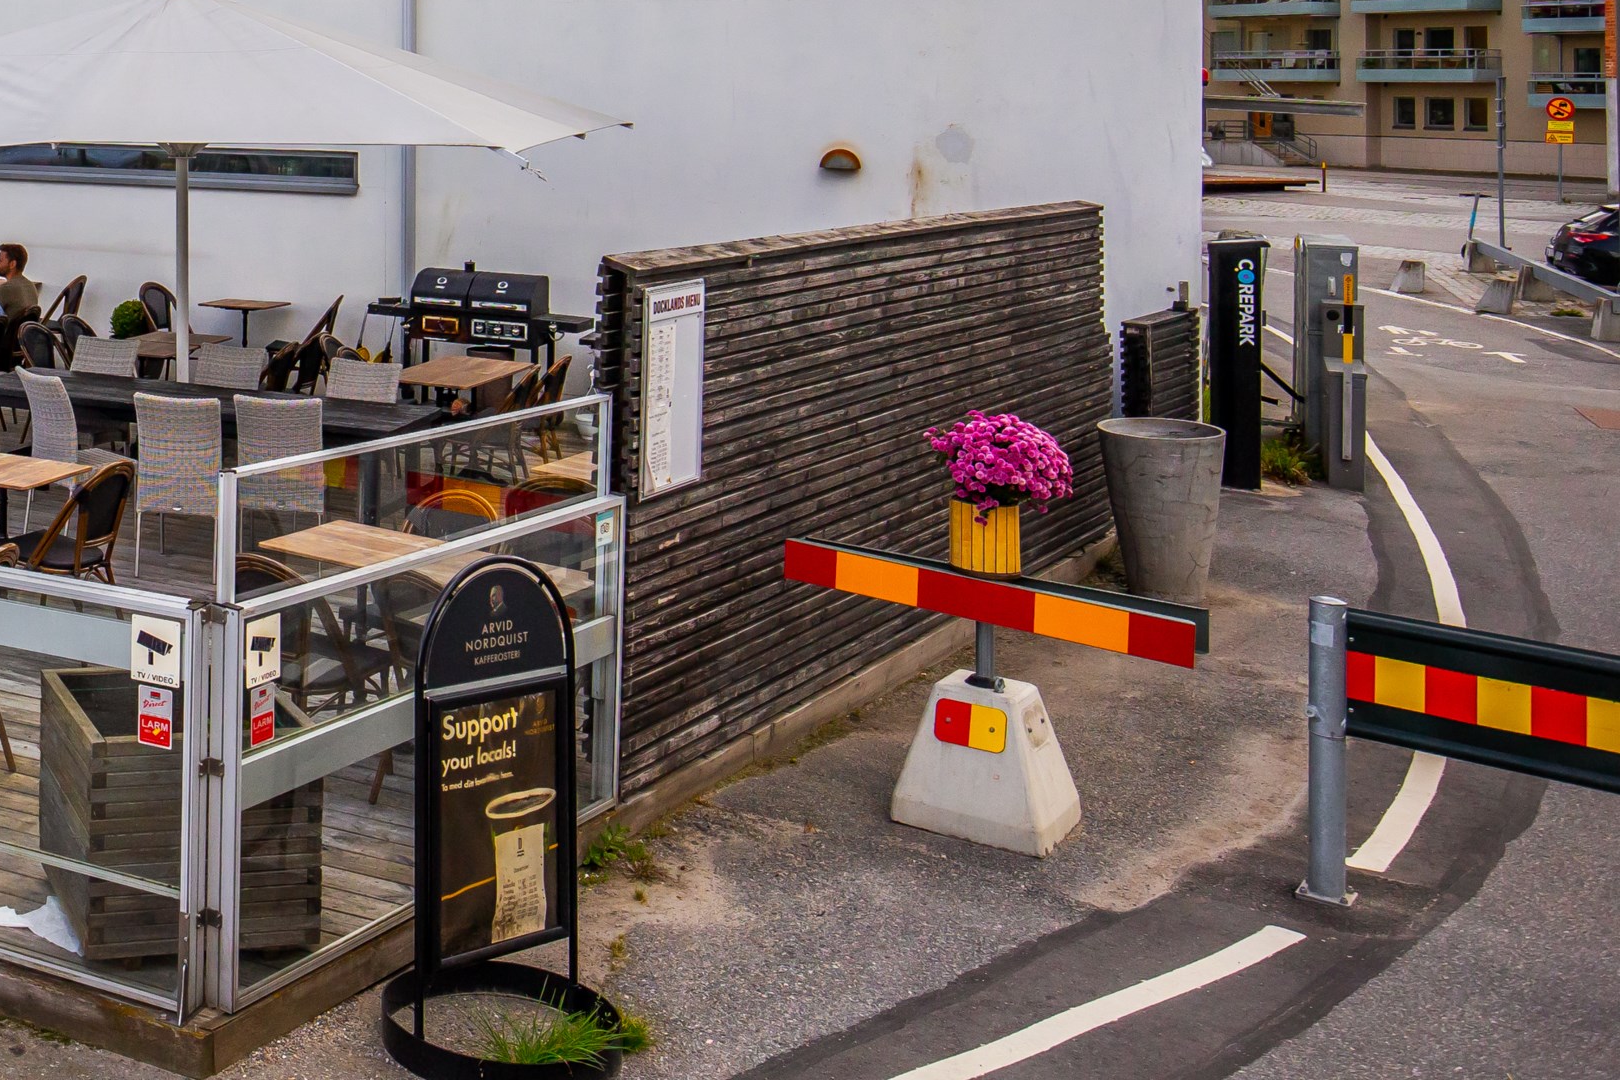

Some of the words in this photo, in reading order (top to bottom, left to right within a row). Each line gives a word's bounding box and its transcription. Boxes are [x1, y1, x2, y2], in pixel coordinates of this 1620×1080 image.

[653, 295, 685, 315] DOCKLANDS
[685, 293, 701, 310] MENU
[1237, 259, 1256, 347] COREPARK
[481, 619, 513, 635] ARVID
[465, 631, 529, 653] NORDQUIST
[474, 650, 521, 666] KAFFEROSTERI
[137, 671, 146, 679] TV
[151, 675, 174, 685] VIDEO
[261, 670, 277, 680] VIDEO
[141, 718, 169, 732] LARM
[253, 715, 272, 730] LARM
[442, 706, 519, 745] Support
[441, 753, 474, 777] your
[476, 739, 517, 766] locals!
